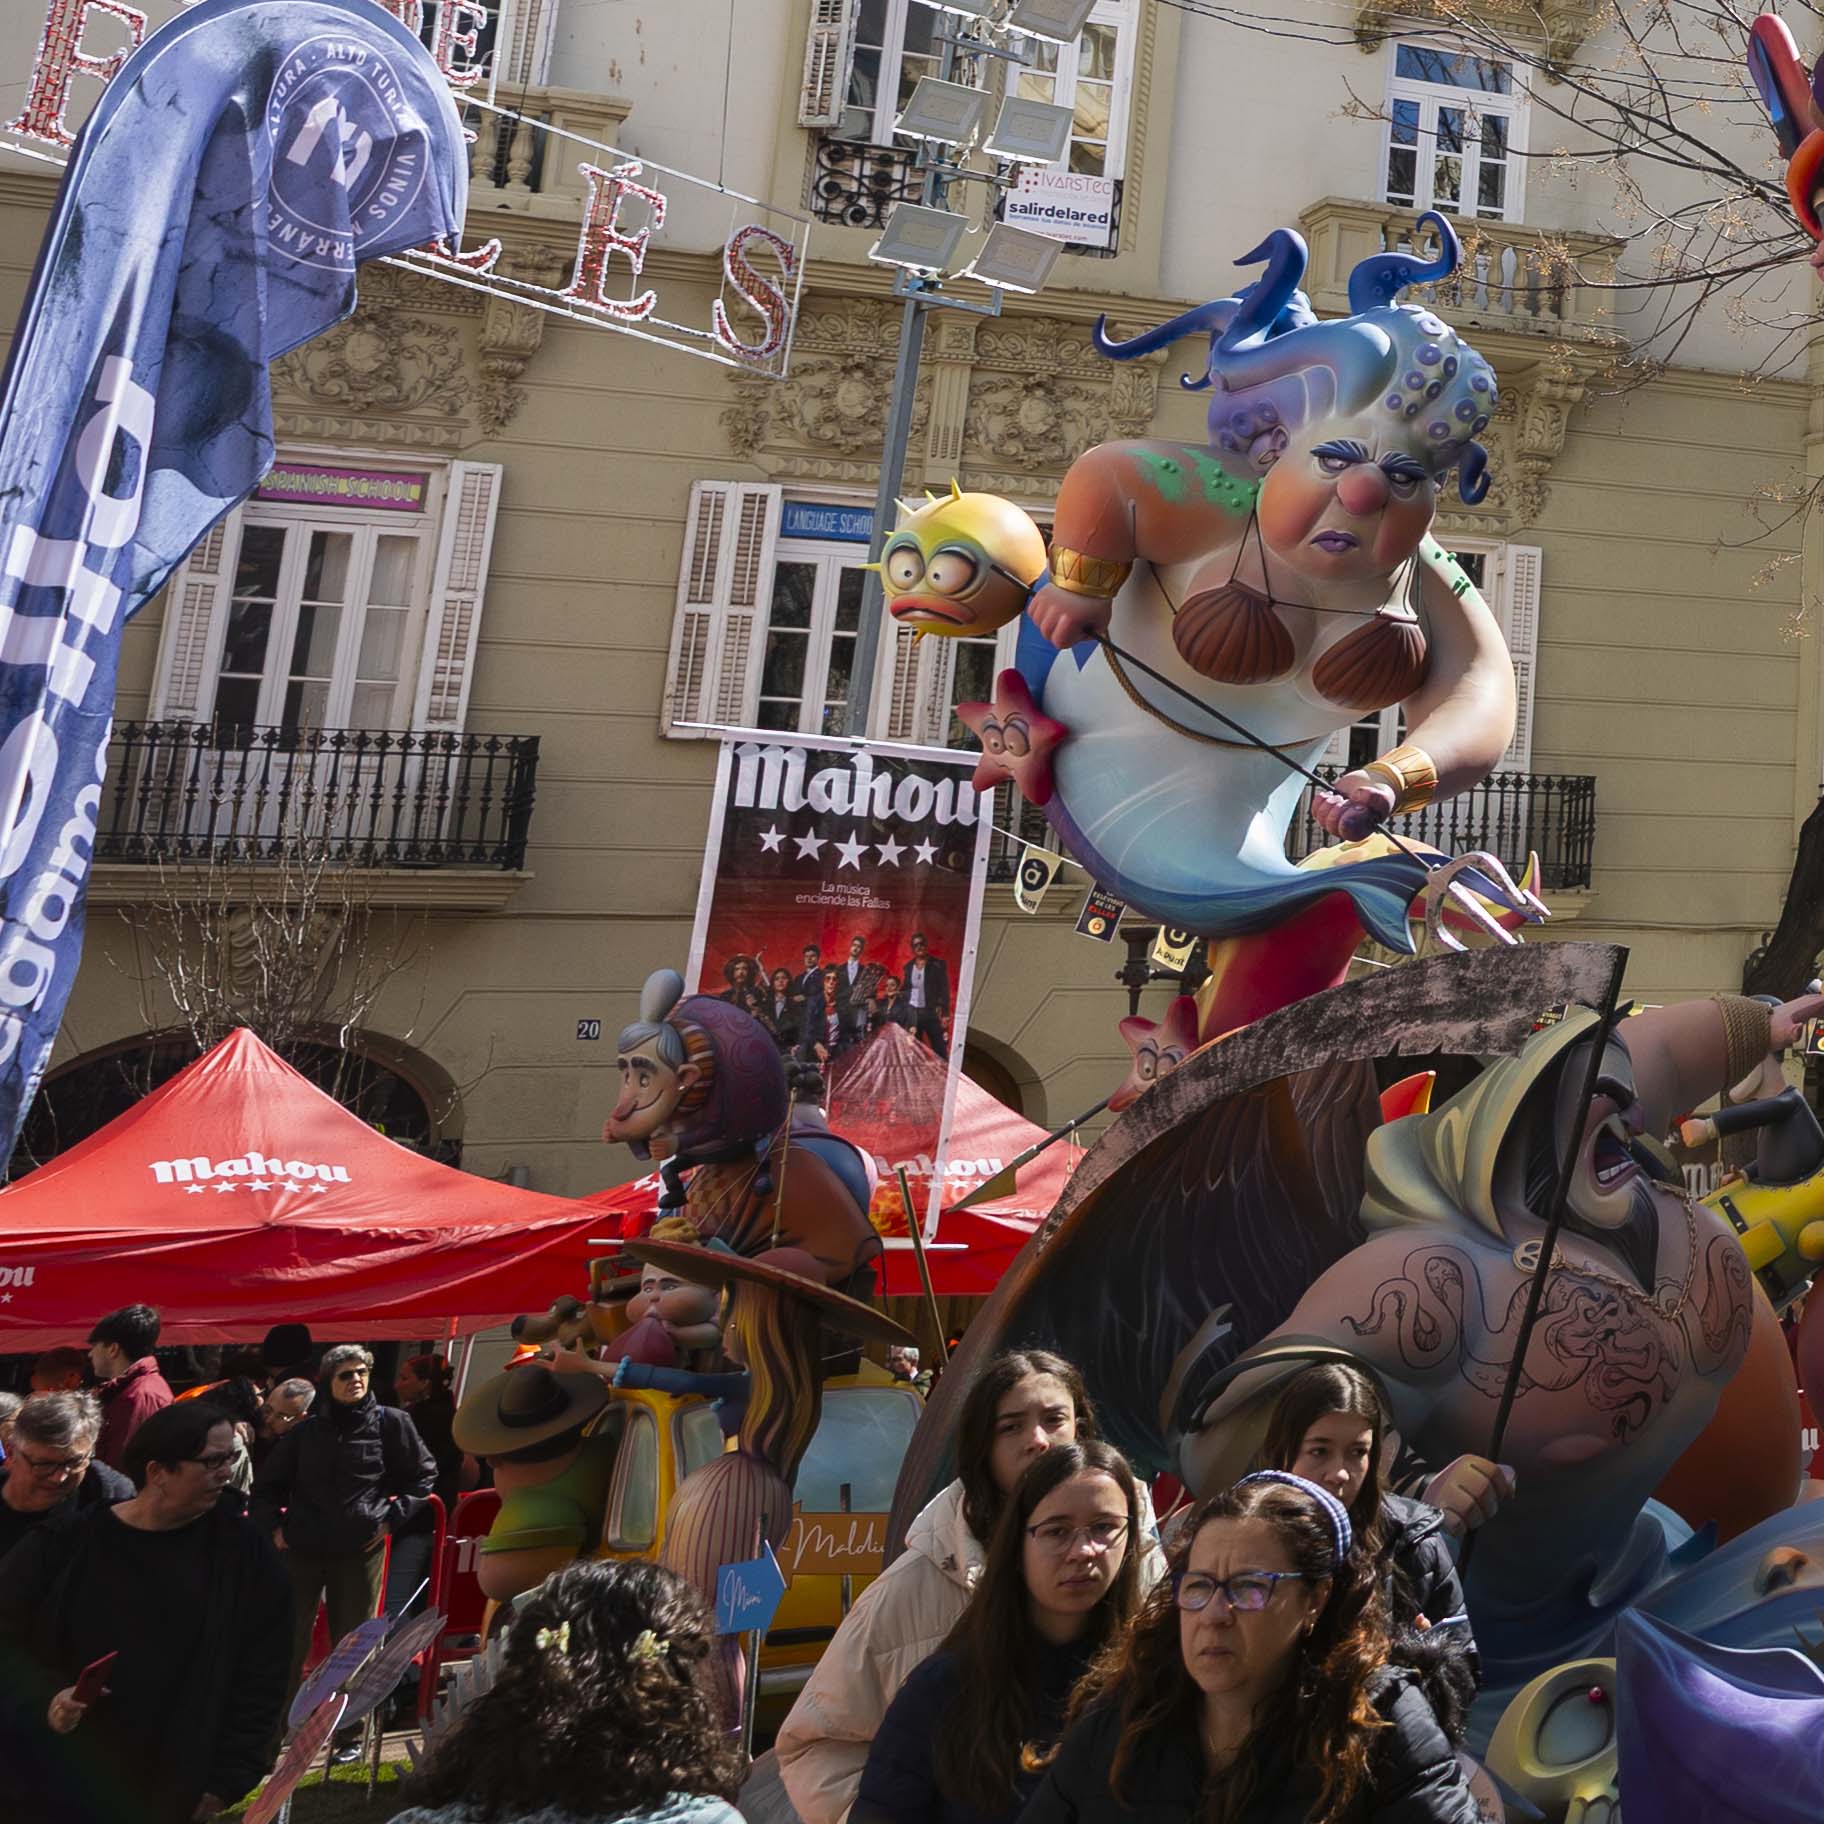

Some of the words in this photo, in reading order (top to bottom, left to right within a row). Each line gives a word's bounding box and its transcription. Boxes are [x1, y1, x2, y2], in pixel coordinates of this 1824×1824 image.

[327, 42, 368, 66] ALTO
[368, 153, 417, 221] VINOS
[1009, 202, 1108, 225] salirdelared
[265, 469, 340, 495] SPANISH
[345, 476, 414, 502] SCHOOL
[787, 510, 837, 533] LANGUAGE
[840, 514, 873, 534] SCHOO
[796, 893, 846, 906] enciende
[848, 895, 860, 907] las
[862, 896, 891, 909] Fallas
[578, 1022, 599, 1038] 20
[149, 1152, 352, 1183] Mahou
